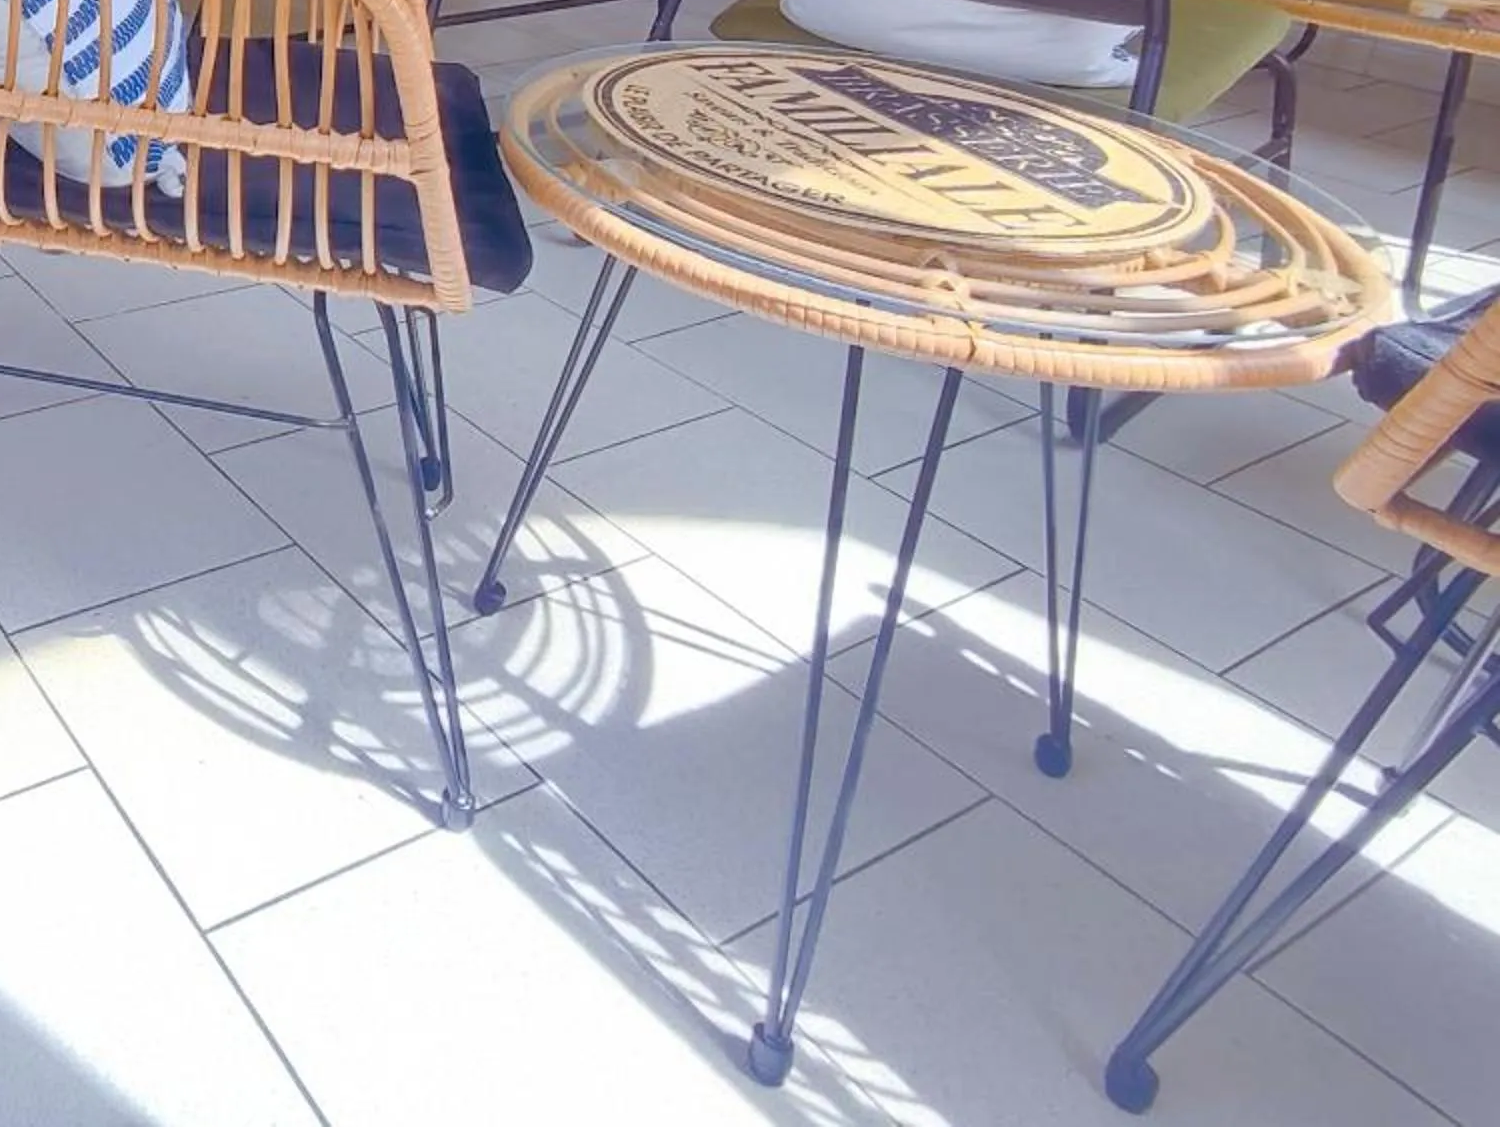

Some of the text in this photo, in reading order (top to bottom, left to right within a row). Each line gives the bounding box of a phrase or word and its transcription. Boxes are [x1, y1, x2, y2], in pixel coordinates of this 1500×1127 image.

[684, 149, 847, 204] PARTAGER
[686, 61, 1094, 230] FAMILIALE
[817, 75, 1123, 196] BRASSERIE
